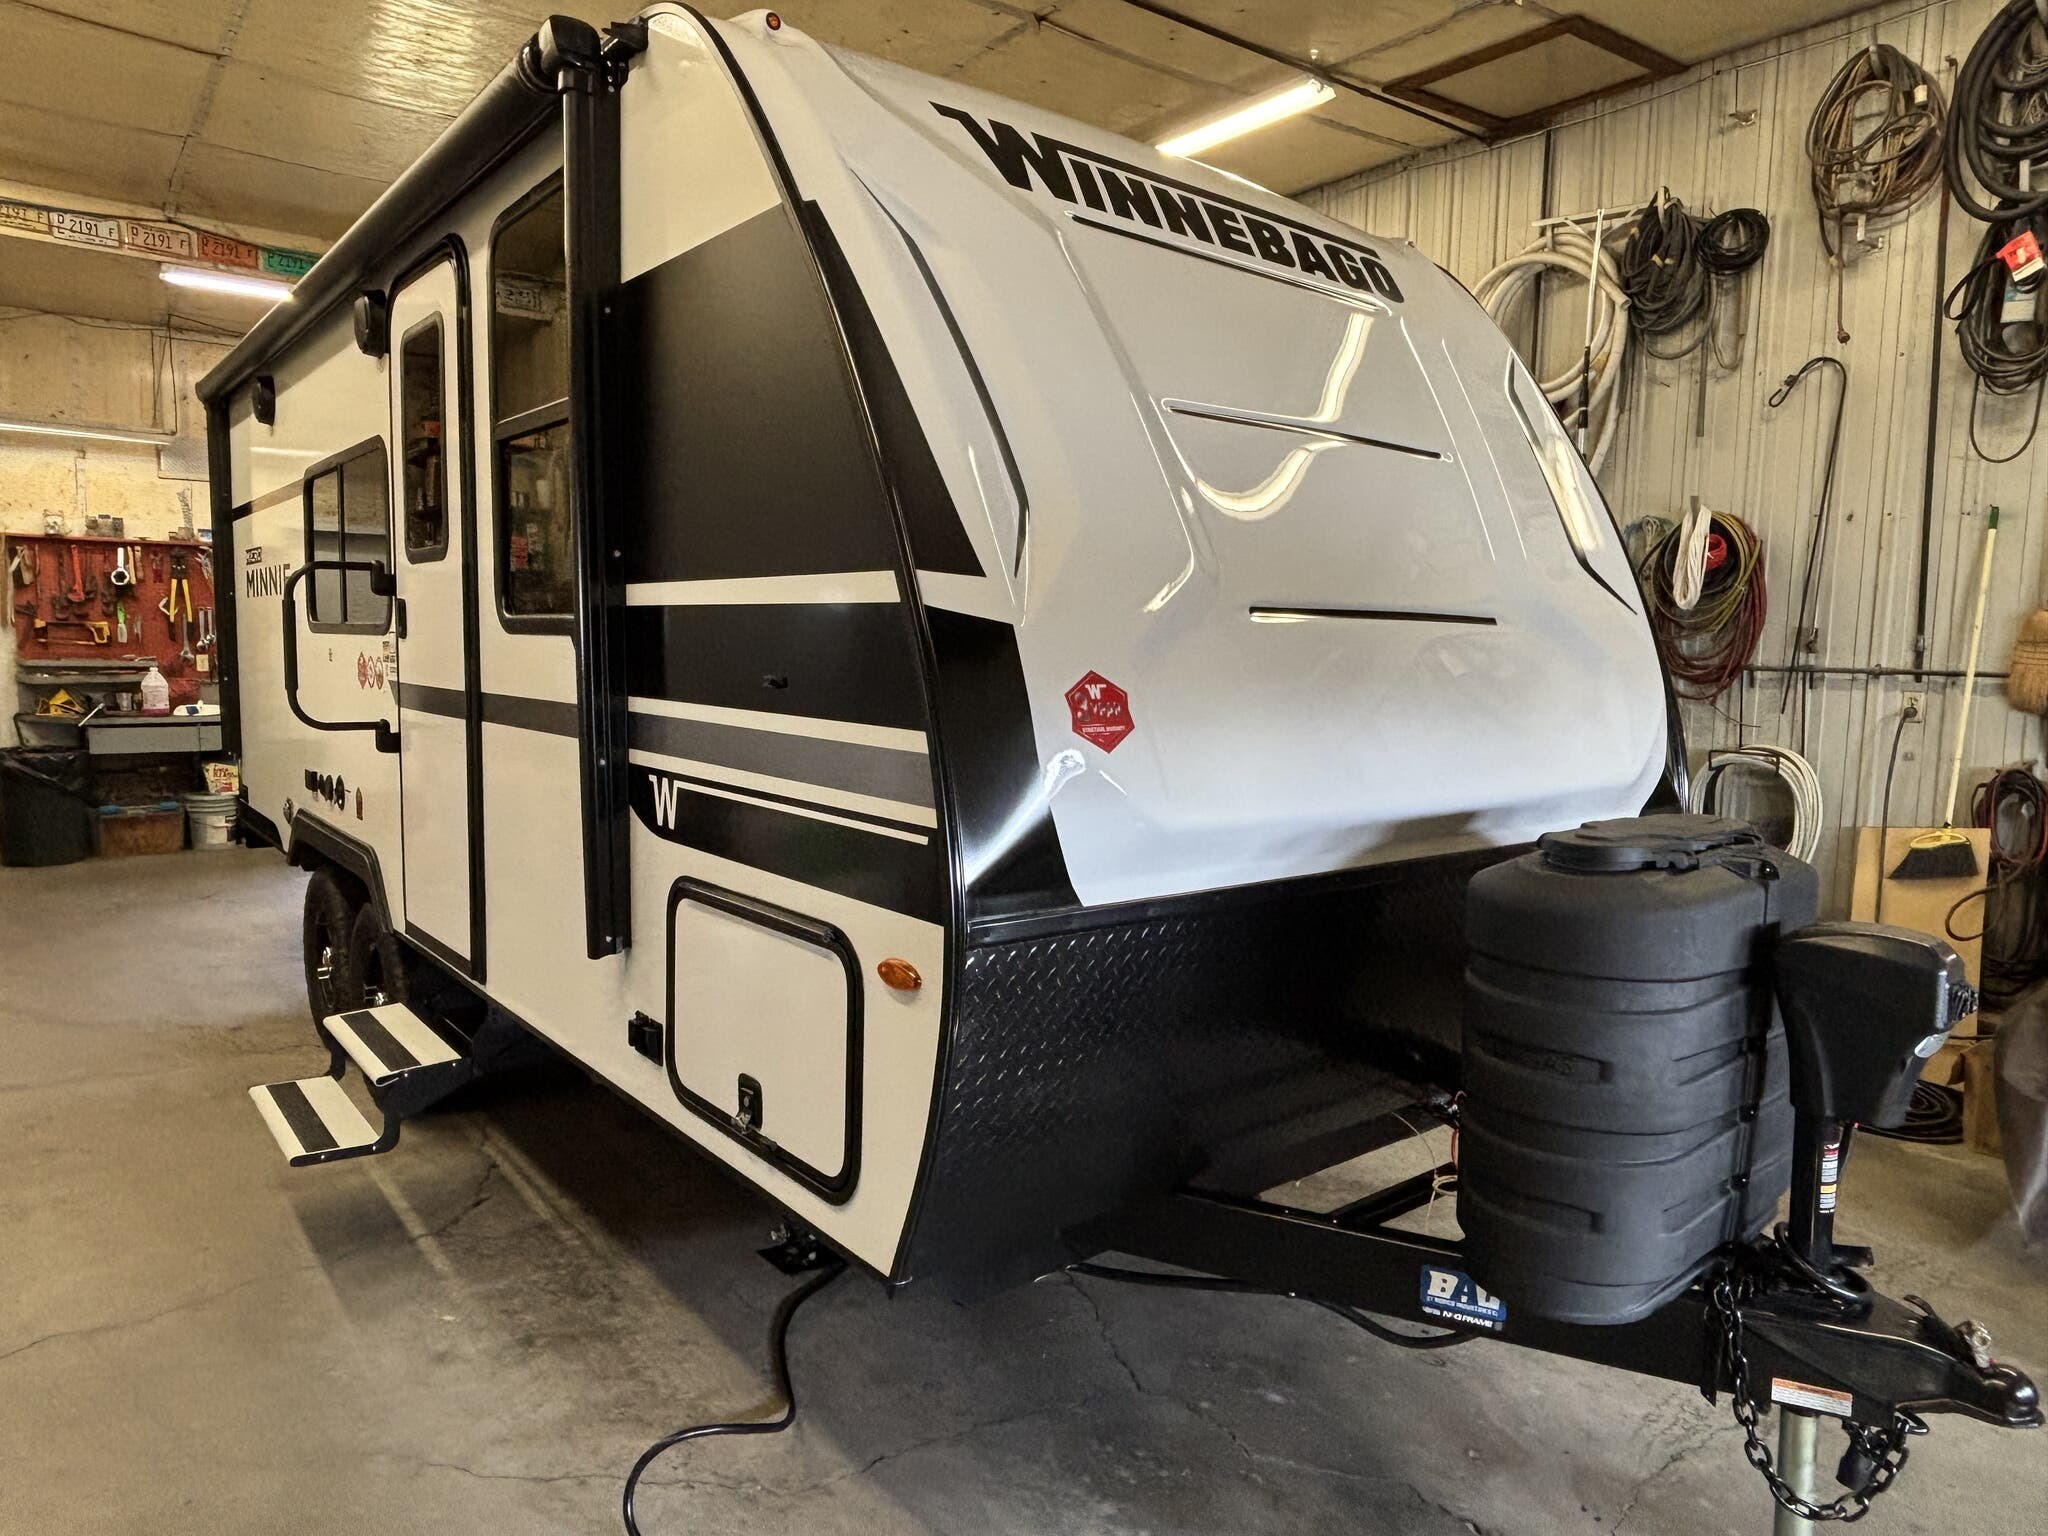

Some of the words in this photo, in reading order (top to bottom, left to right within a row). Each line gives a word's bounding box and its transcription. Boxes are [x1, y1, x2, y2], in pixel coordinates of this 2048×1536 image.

[928, 100, 1405, 304] WINNEBAGO
[69, 218, 99, 237] 2191
[143, 231, 173, 249] 2191
[211, 240, 241, 260] 2191
[1084, 683, 1107, 700] W
[649, 774, 679, 831] W
[1427, 1270, 1501, 1311] BAL
